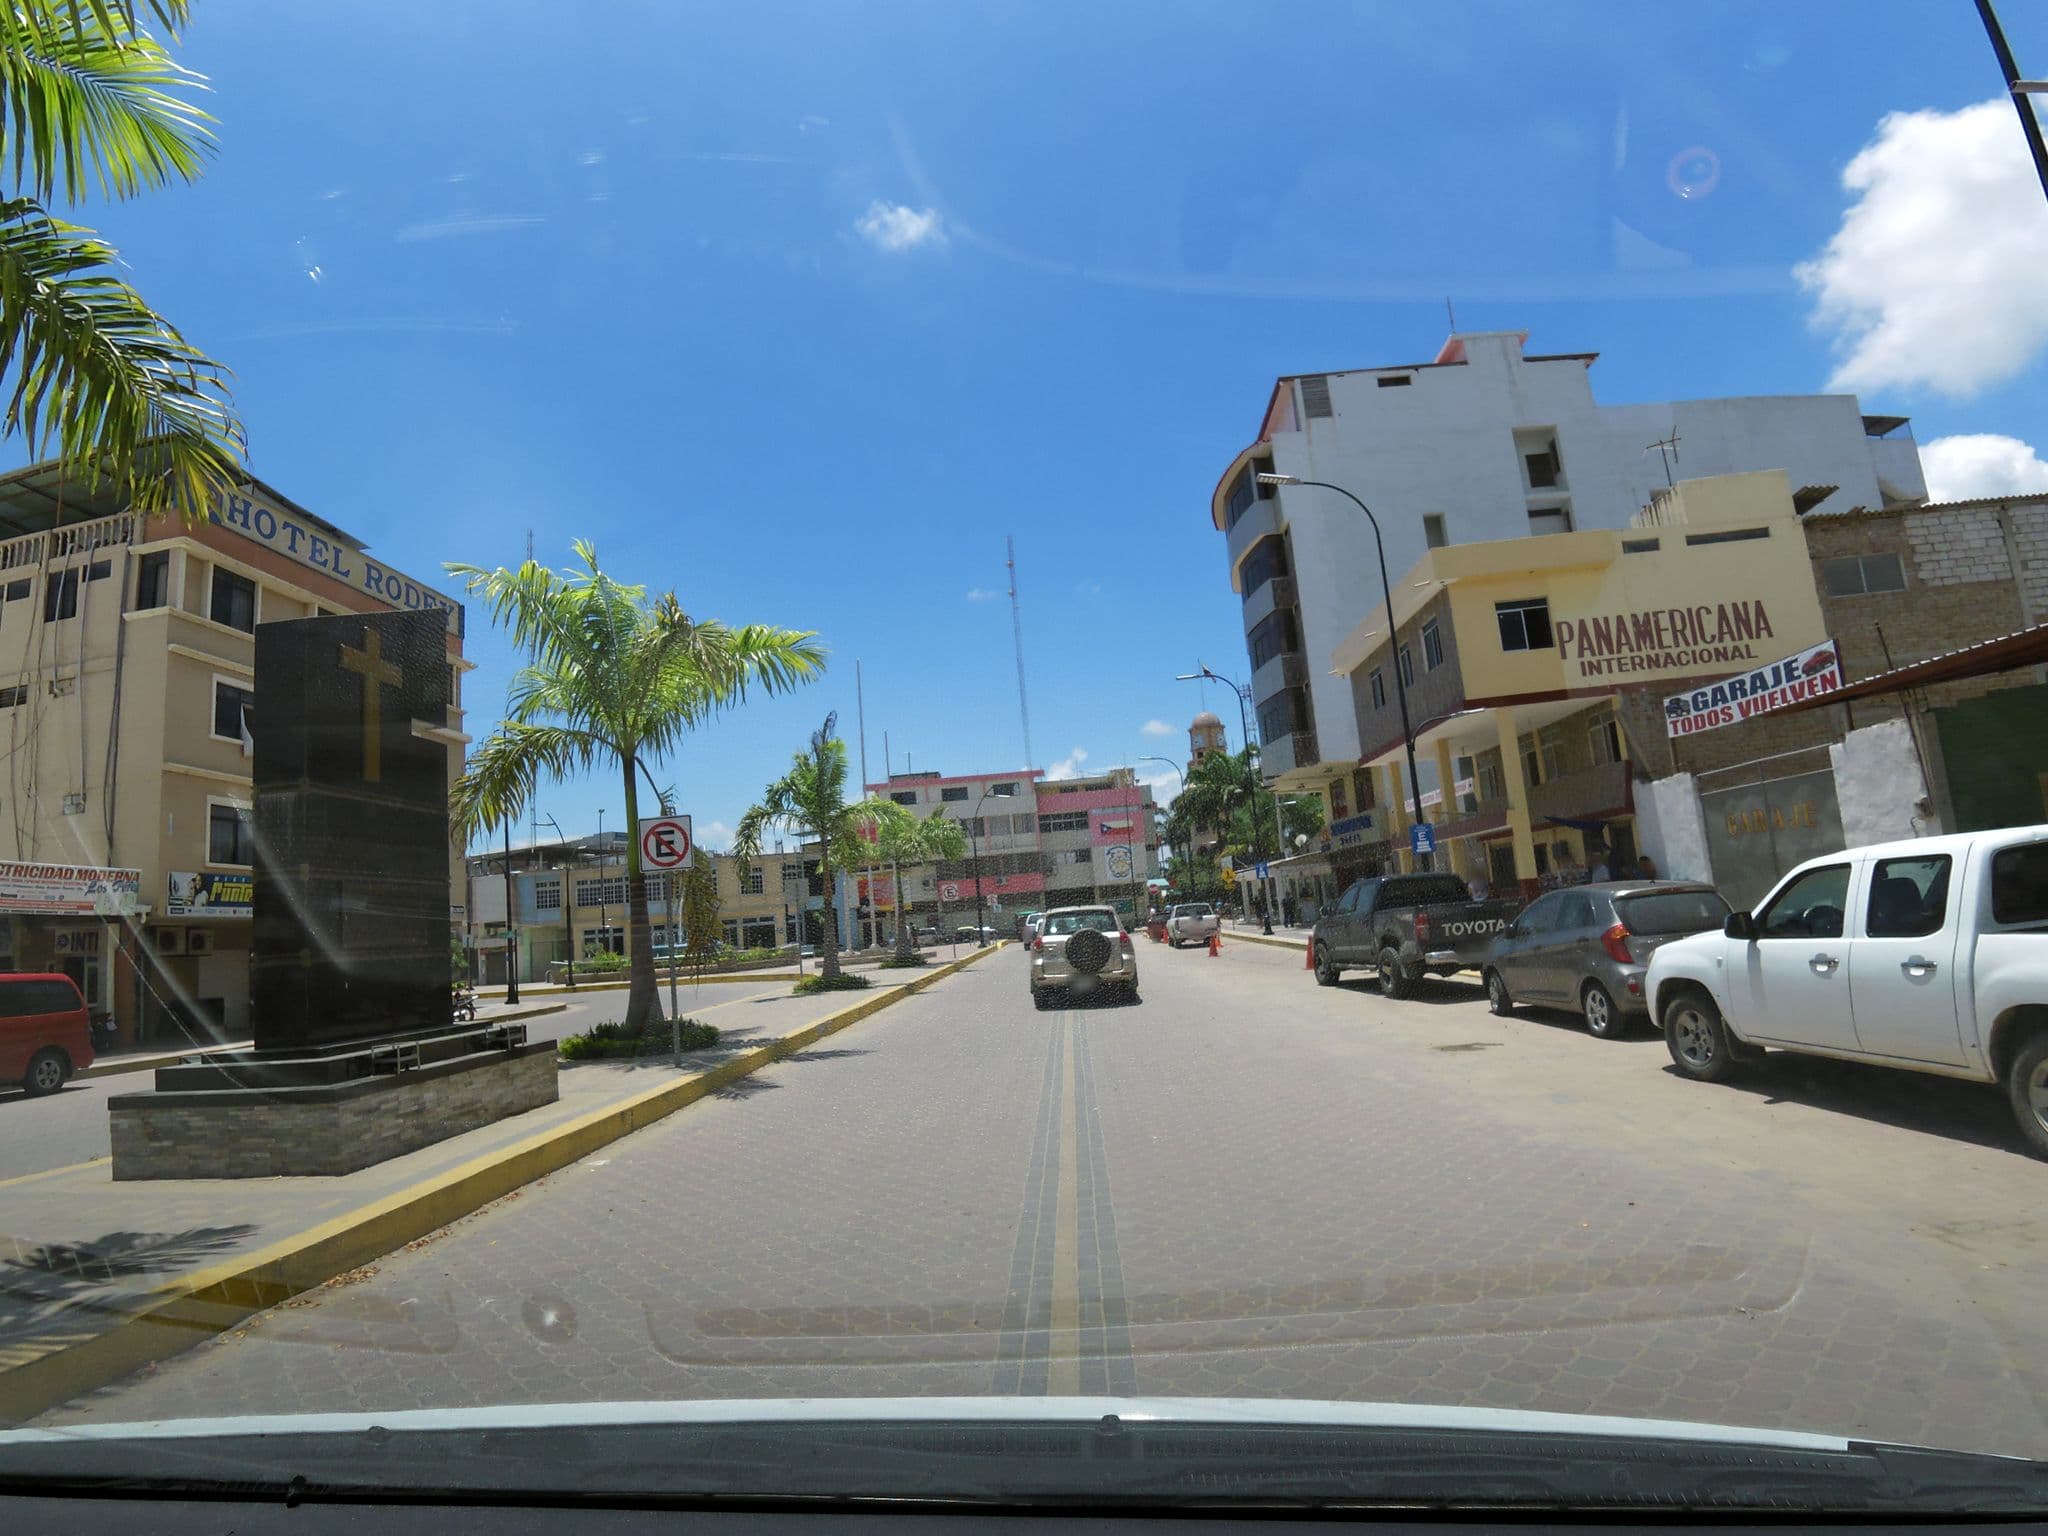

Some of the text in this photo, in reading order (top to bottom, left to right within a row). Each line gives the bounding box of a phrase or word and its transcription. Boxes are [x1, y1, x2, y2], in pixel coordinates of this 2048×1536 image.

[228, 494, 351, 578] HOTEL
[1556, 599, 1774, 660] PANAMERICANA
[1580, 643, 1759, 677] INTERNACIONAL
[1668, 670, 1839, 736] TODOS VUELVEN
[1691, 656, 1802, 713] GARAJE
[1727, 800, 1817, 838] GARAJE
[656, 829, 675, 858] E
[76, 868, 141, 882] MODERNA
[1441, 918, 1506, 937] TOYOTA
